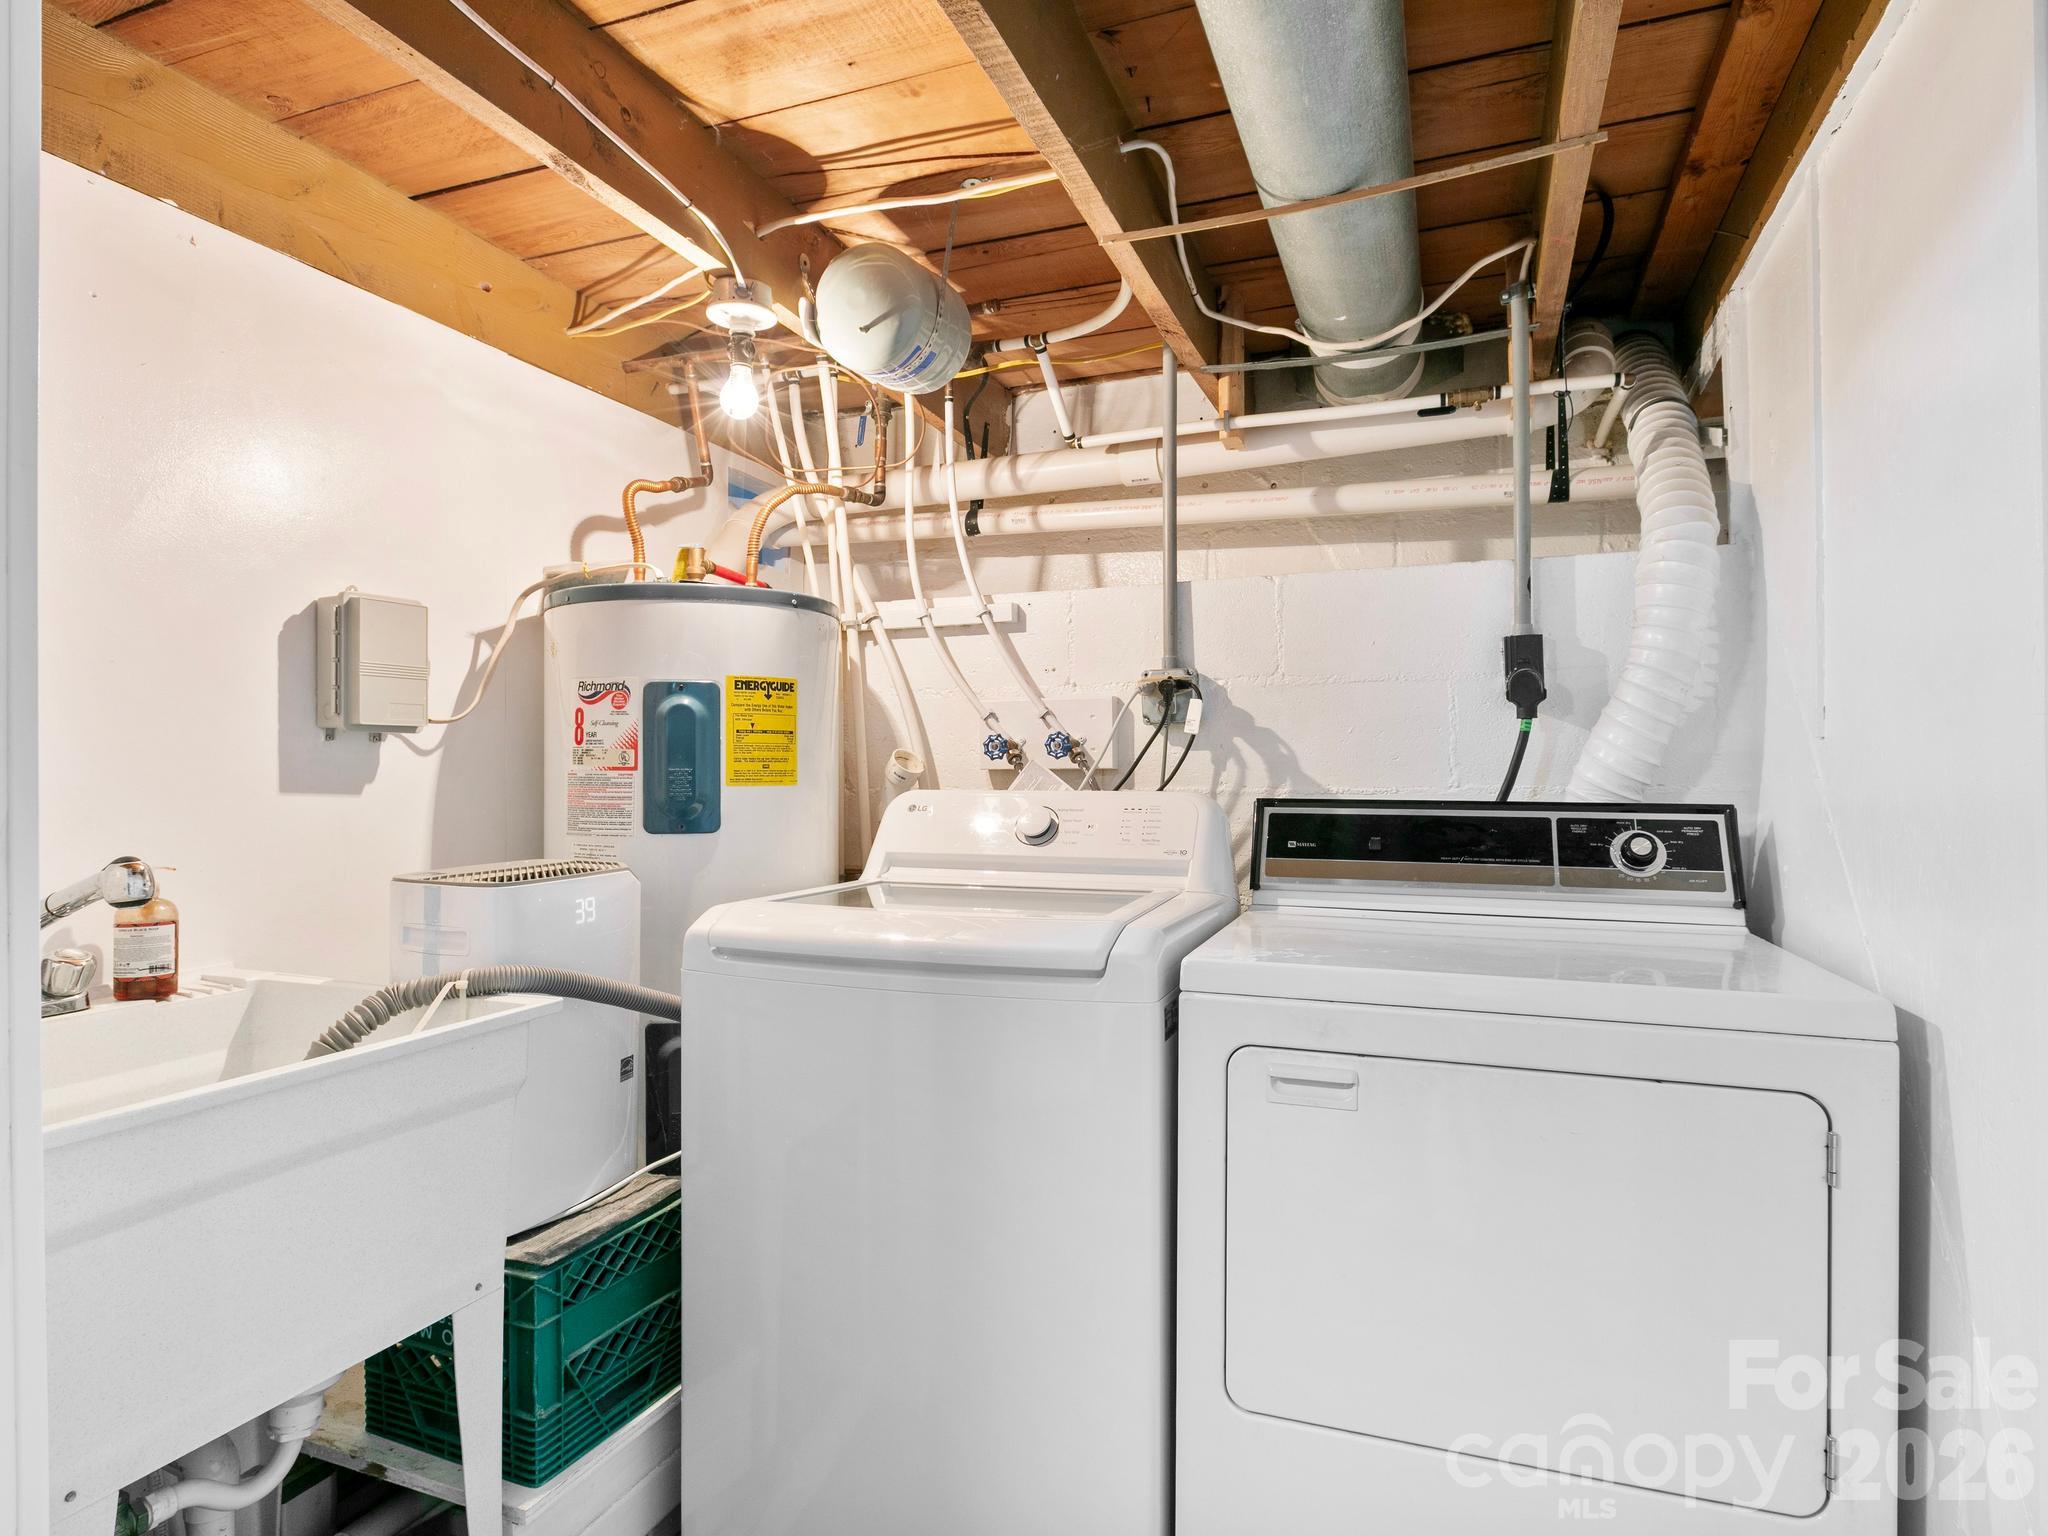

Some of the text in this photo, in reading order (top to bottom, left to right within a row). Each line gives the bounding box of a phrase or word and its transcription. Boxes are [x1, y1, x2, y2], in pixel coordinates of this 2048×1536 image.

[577, 680, 626, 692] Richmond
[734, 679, 795, 696] ENERGYGUIDE
[574, 707, 585, 746] 8
[575, 896, 597, 925] 39
